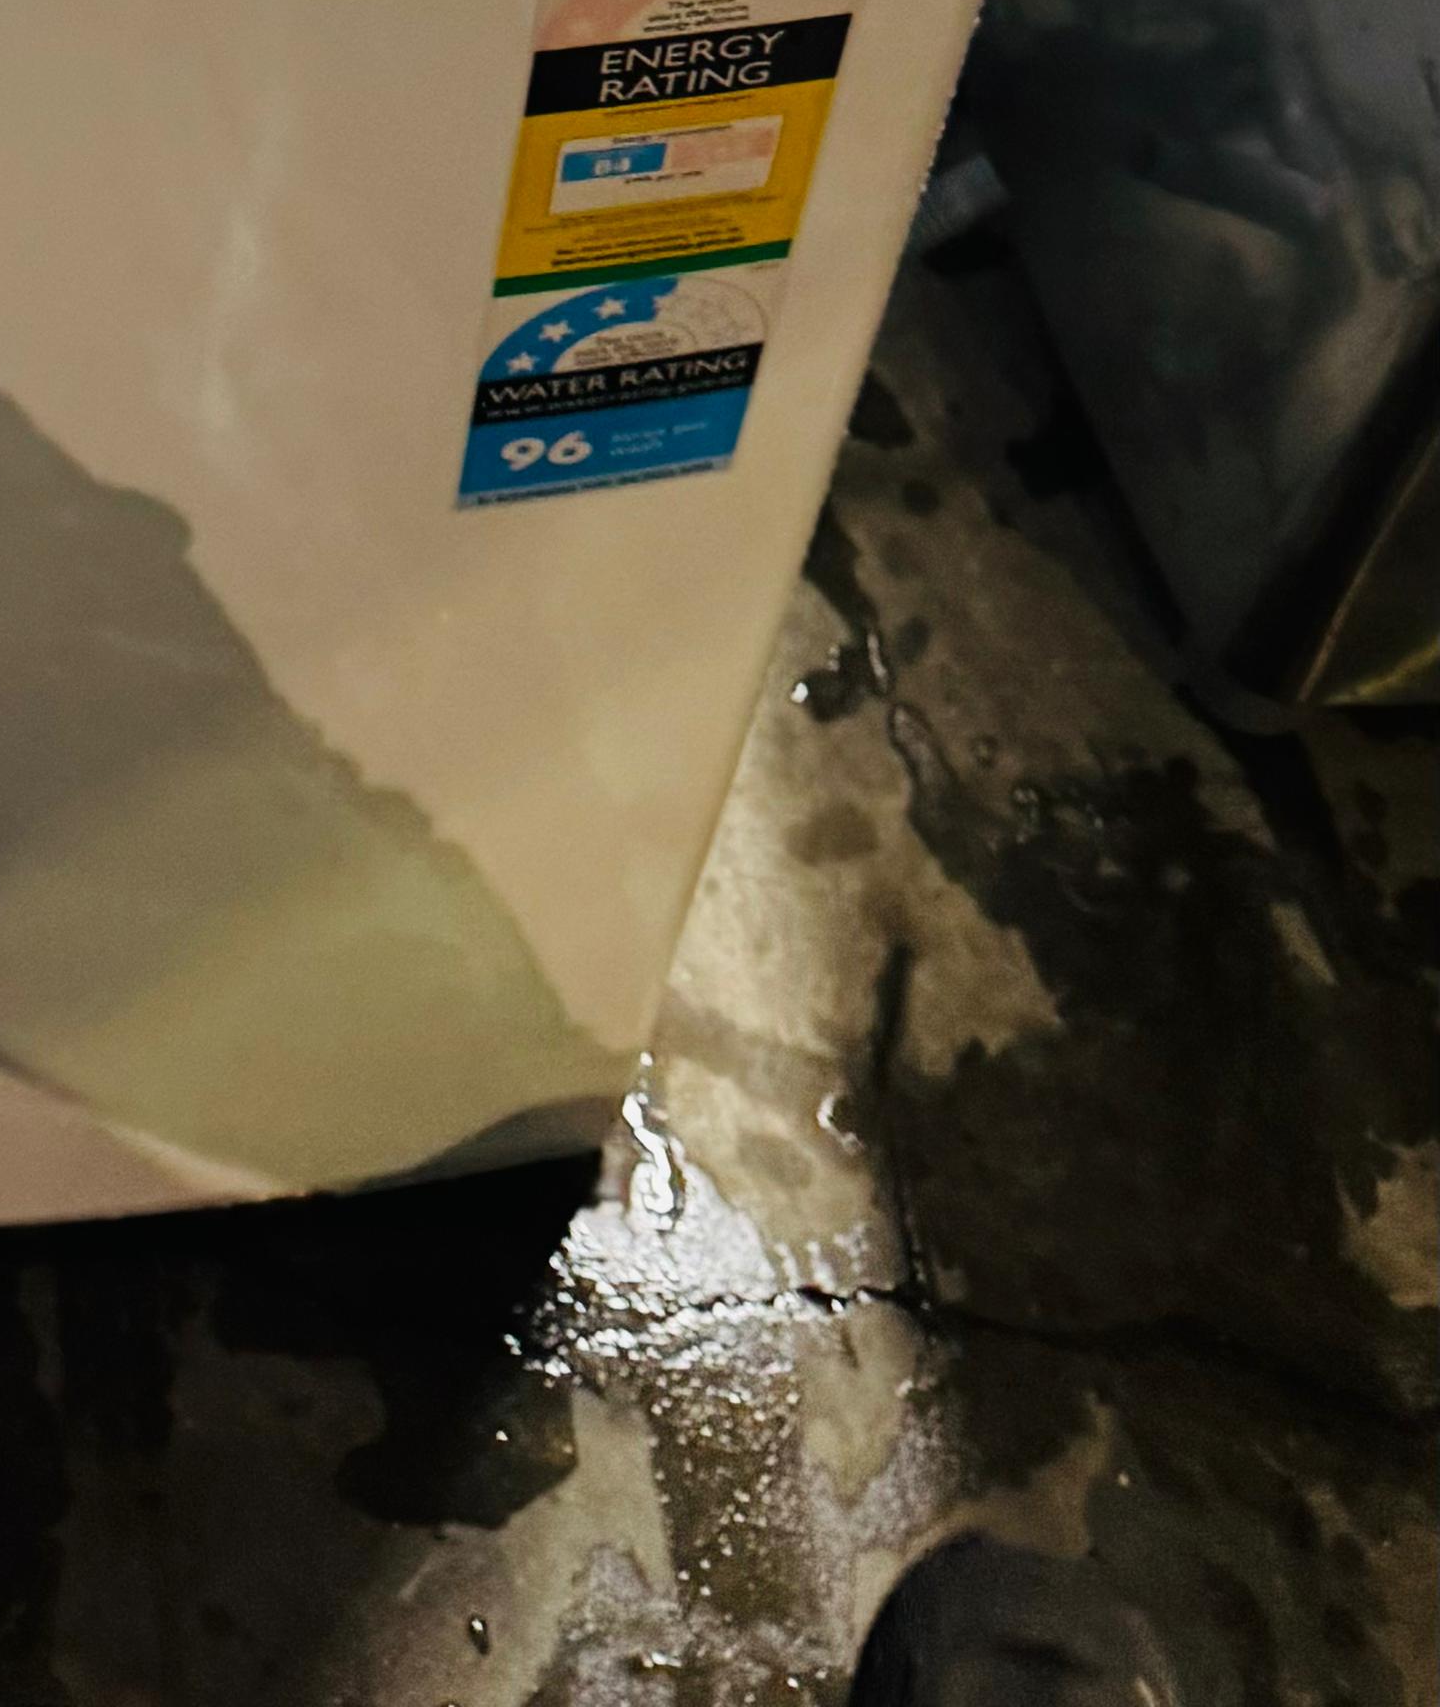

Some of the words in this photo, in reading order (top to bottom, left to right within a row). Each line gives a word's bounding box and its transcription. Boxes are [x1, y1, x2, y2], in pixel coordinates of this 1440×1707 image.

[599, 30, 785, 75] ENERGY
[598, 60, 772, 103] RATING
[487, 373, 607, 405] WATER
[619, 350, 750, 387] RATING
[500, 430, 593, 471] 96
